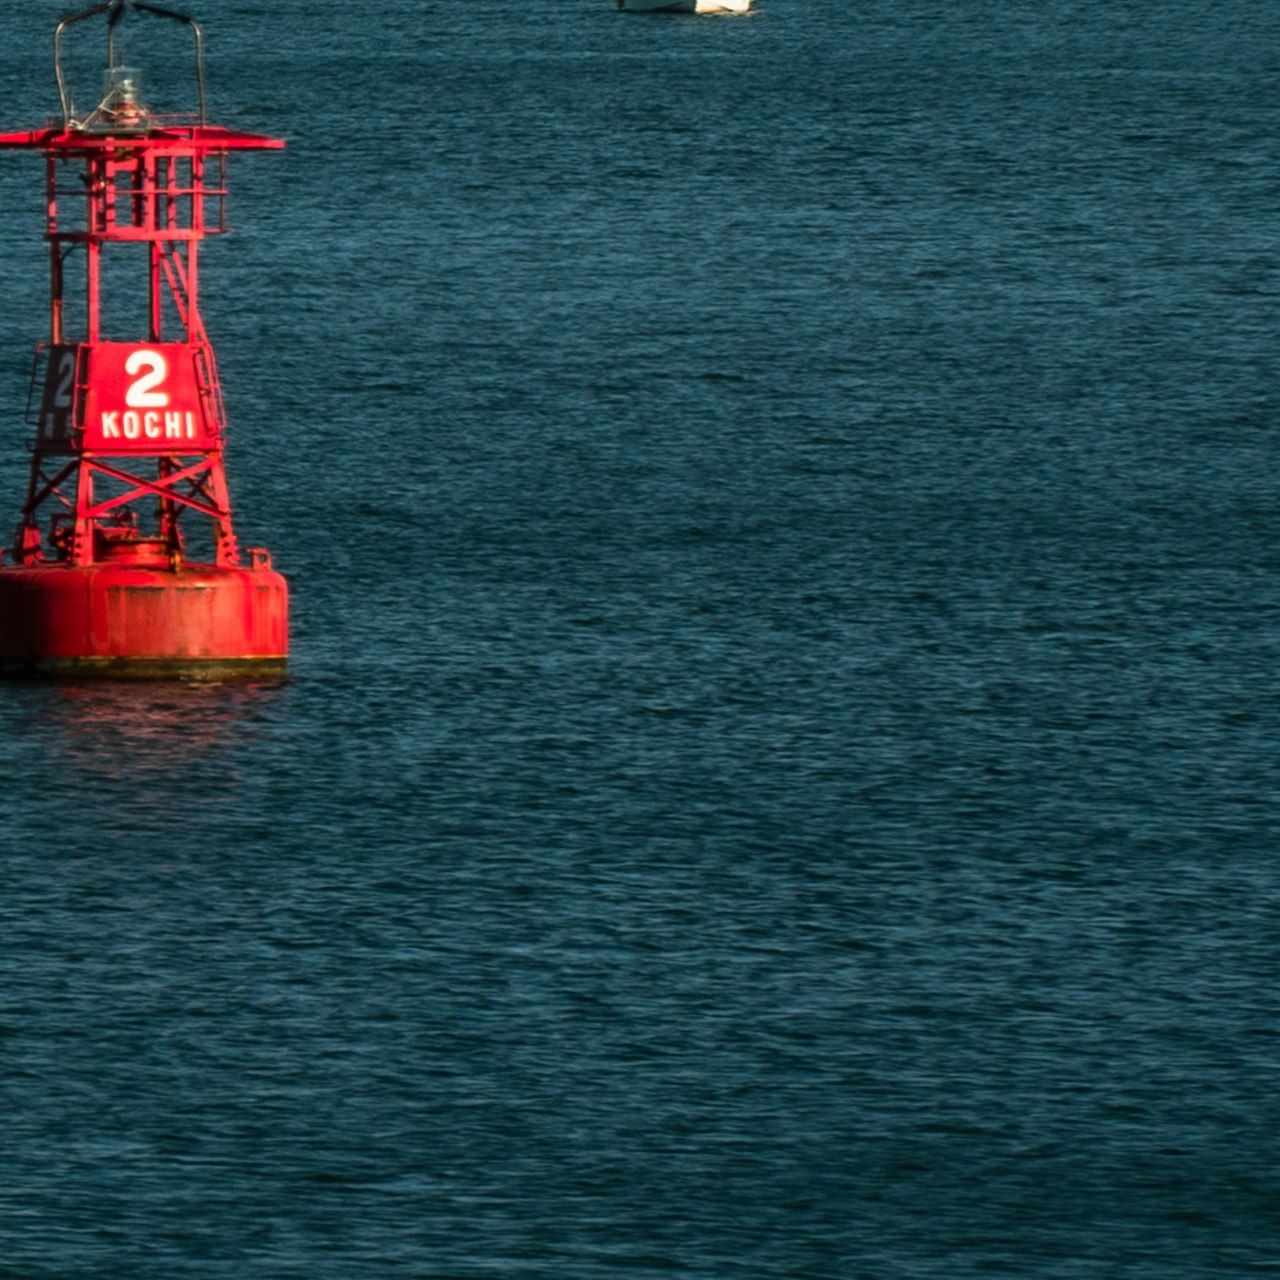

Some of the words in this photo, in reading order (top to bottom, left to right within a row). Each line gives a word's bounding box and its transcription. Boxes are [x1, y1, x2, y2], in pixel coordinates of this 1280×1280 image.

[53, 350, 75, 408] 2
[125, 349, 170, 408] 2
[101, 411, 194, 439] KOCHI
